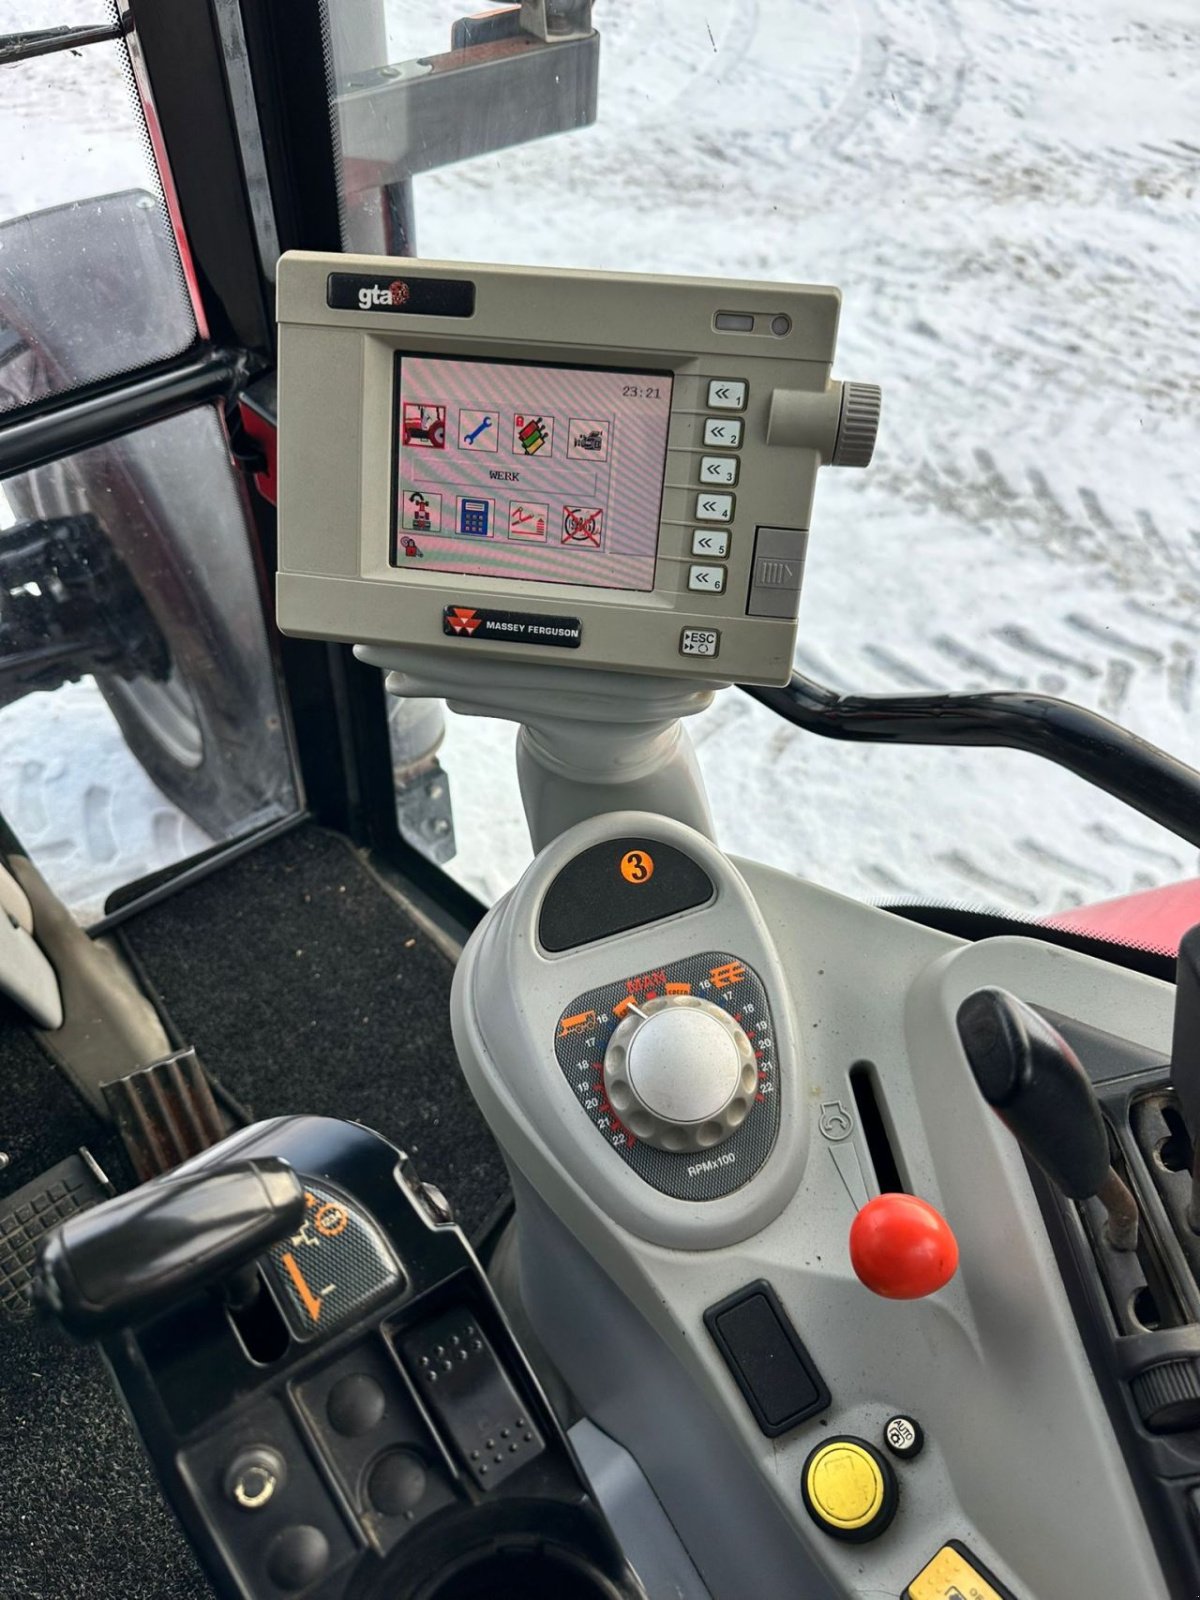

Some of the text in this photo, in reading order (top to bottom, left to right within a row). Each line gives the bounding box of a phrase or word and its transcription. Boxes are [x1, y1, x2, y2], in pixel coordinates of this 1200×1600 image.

[358, 284, 393, 309] gta
[622, 386, 661, 399] 23:21
[736, 397, 741, 406] 1
[730, 435, 737, 444] 2
[489, 470, 520, 482] WERK
[726, 473, 732, 481] 3
[722, 509, 728, 518] 4
[718, 546, 725, 554] 5
[714, 581, 720, 589] 6
[486, 621, 579, 638] MASSEY FERGUSON
[690, 632, 715, 644] ESC
[627, 853, 648, 880] 3
[626, 970, 667, 994] MAN
[699, 979, 711, 990] 16
[723, 990, 733, 1001] 17
[596, 1013, 608, 1024] 16
[756, 1021, 767, 1031] 19
[585, 1036, 596, 1048] 17
[758, 1038, 771, 1049] 20
[576, 1060, 589, 1071] 18
[761, 1061, 773, 1072] 21
[578, 1081, 590, 1092] 19
[760, 1082, 774, 1093] 22
[585, 1097, 598, 1109] 20
[597, 1117, 610, 1129] 21
[612, 1133, 626, 1146] 22
[687, 1152, 736, 1178] RPMx100
[893, 1420, 914, 1441] AUTO
